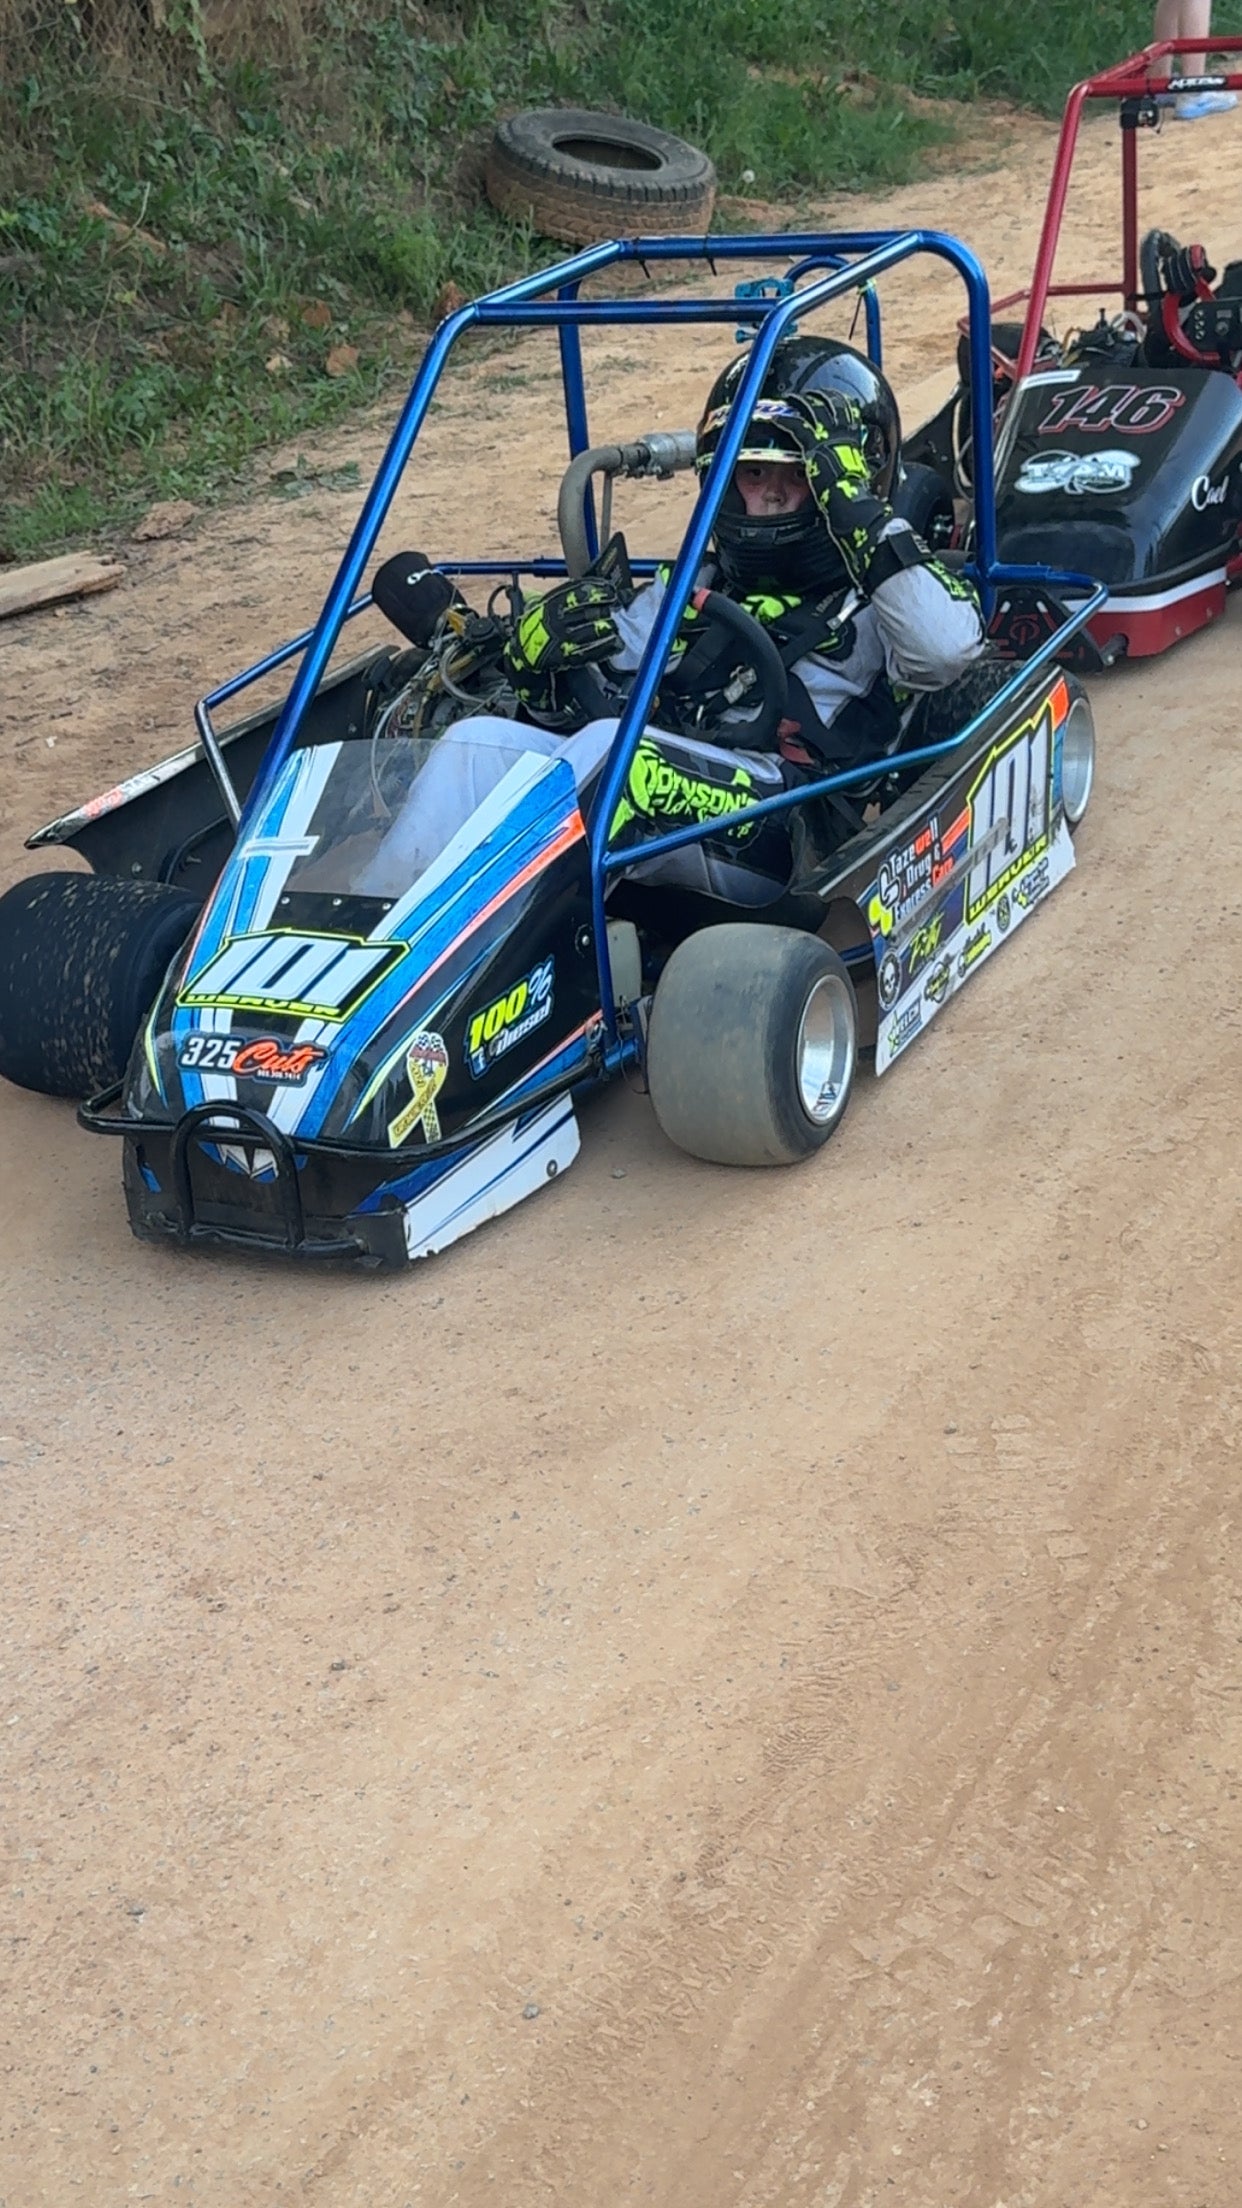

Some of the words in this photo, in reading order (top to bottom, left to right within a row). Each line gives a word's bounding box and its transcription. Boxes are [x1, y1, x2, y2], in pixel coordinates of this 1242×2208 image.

[1038, 385, 1187, 433] 146
[969, 718, 1048, 903] 101
[906, 853, 931, 888] Drug
[188, 936, 393, 1006] 101
[469, 960, 553, 1053] 100%
[181, 1037, 242, 1069] 325
[232, 1039, 324, 1073] Cuts
